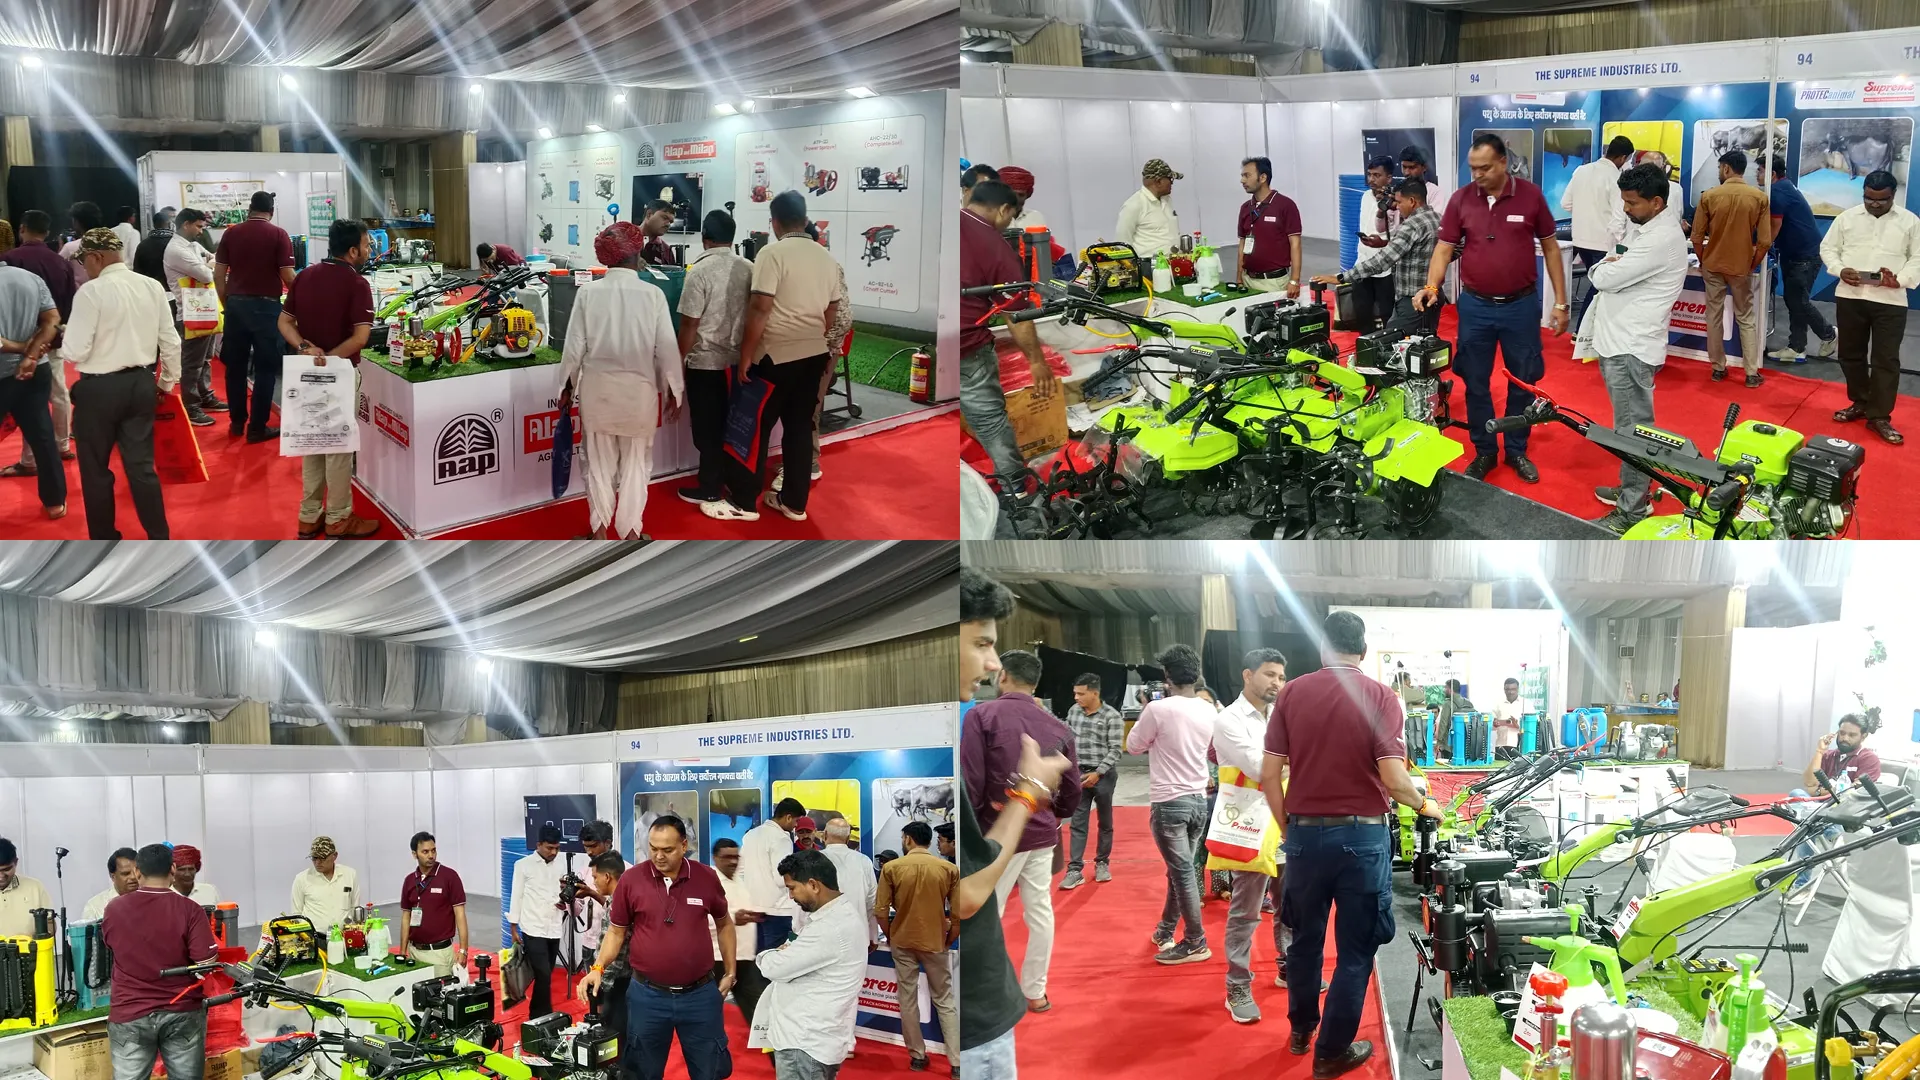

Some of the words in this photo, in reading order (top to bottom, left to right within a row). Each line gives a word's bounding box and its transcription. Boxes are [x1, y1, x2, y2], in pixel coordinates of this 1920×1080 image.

[1904, 46, 1920, 59] TH
[1797, 53, 1813, 65] 94
[1535, 70, 1551, 81] THE
[1554, 67, 1597, 80] SUPREME
[1600, 63, 1658, 77] INDUSTRIES
[1660, 62, 1681, 74] LTD.
[1470, 74, 1480, 83] 94
[1864, 81, 1915, 94] Supreme
[1801, 89, 1856, 100] PROTECanimal
[1493, 107, 1500, 119] के
[1518, 108, 1524, 119] के
[664, 146, 684, 158] Alap
[690, 144, 715, 156] Milap
[698, 737, 715, 747] THE
[718, 733, 763, 746] SUPREME
[767, 729, 828, 742] INDUSTRIES
[832, 728, 854, 739] LTD.
[631, 741, 641, 750] 94
[655, 771, 662, 782] के
[681, 770, 687, 781] के
[1231, 821, 1260, 833] Prabhat
